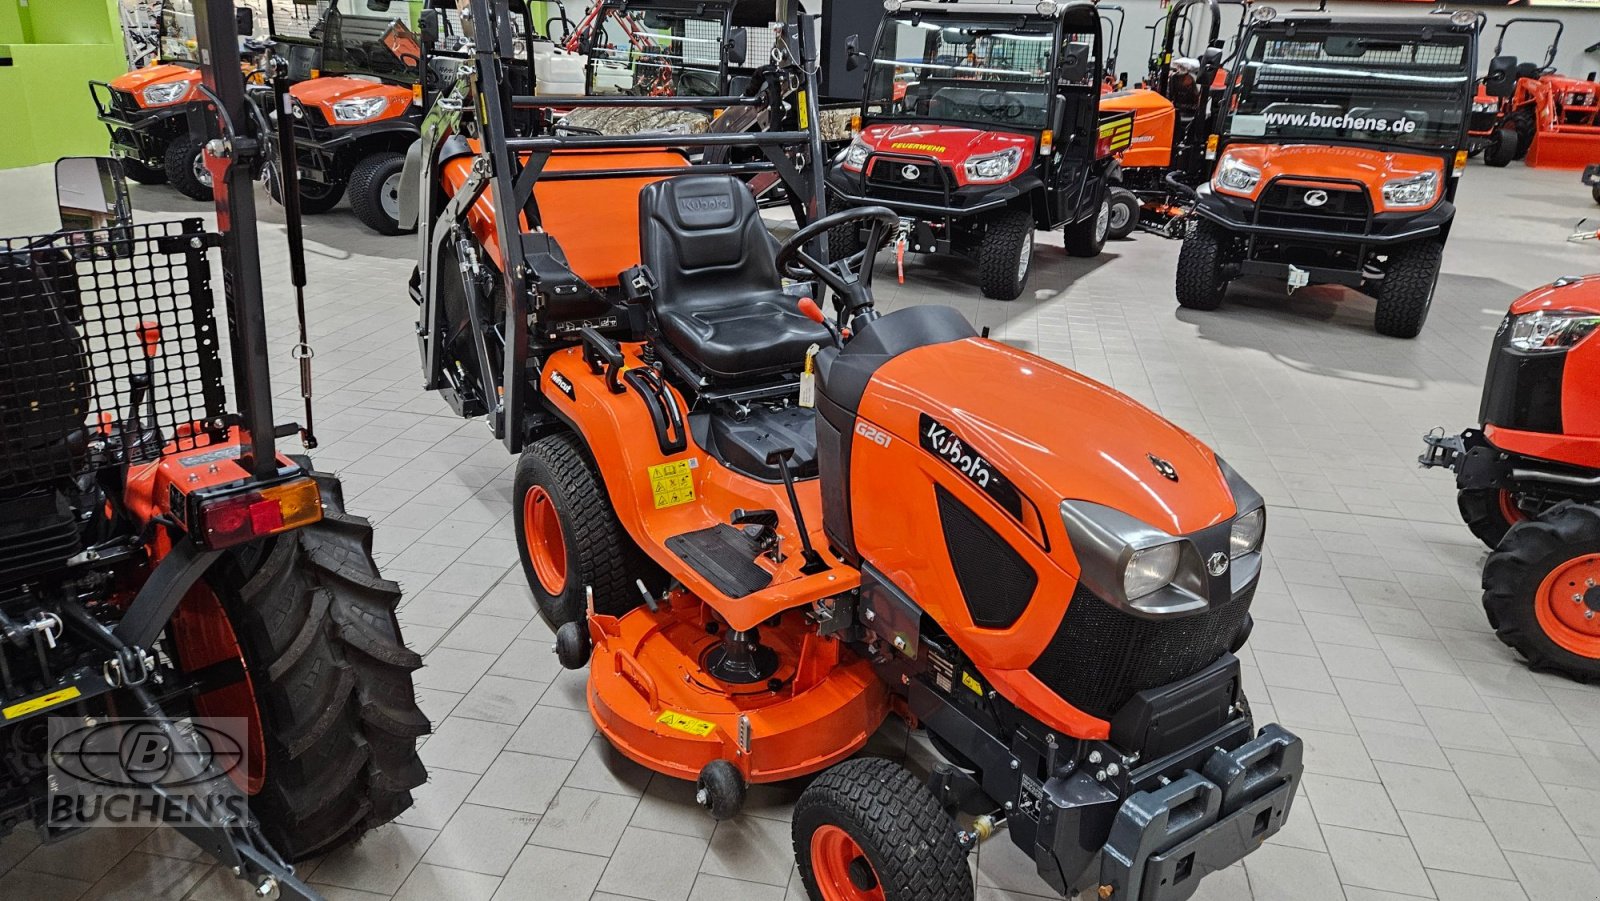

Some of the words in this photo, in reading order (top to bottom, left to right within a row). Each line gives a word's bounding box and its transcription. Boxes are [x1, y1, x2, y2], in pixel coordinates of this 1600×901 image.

[1264, 111, 1416, 133] www.buchens.de
[892, 142, 946, 153] FEUERWEHR
[682, 198, 727, 210] Kubota
[855, 422, 892, 448] G261
[927, 422, 990, 488] Kubota
